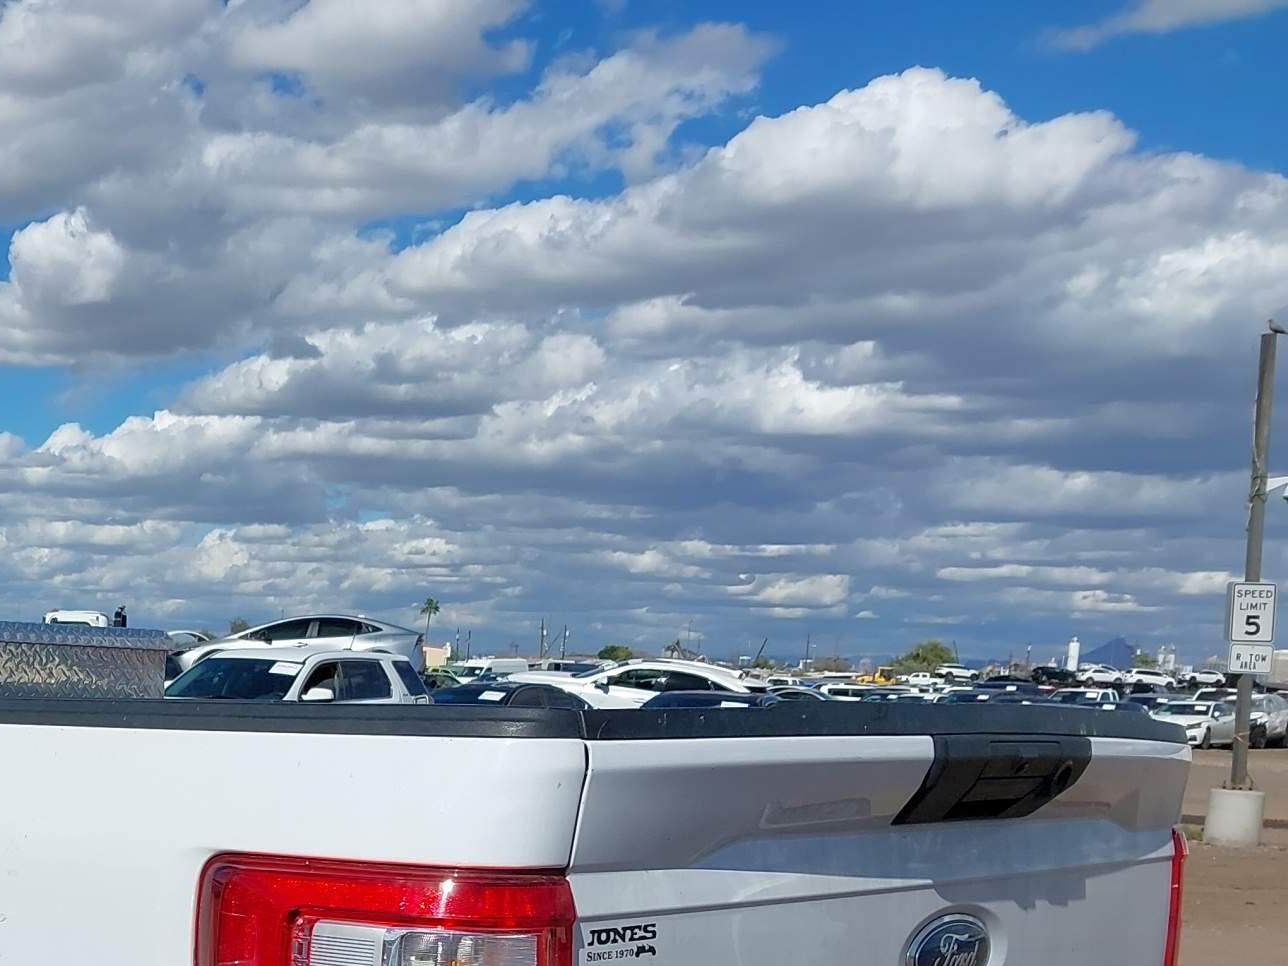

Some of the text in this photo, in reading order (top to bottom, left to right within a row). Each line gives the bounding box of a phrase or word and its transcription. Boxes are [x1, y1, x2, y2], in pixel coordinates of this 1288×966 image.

[1236, 589, 1273, 599] SPEED
[1239, 602, 1268, 611] LIMIT
[1244, 615, 1261, 636] 5
[1249, 653, 1267, 663] TOW
[587, 923, 657, 946] JONES
[586, 948, 634, 962] SINCE 1970
